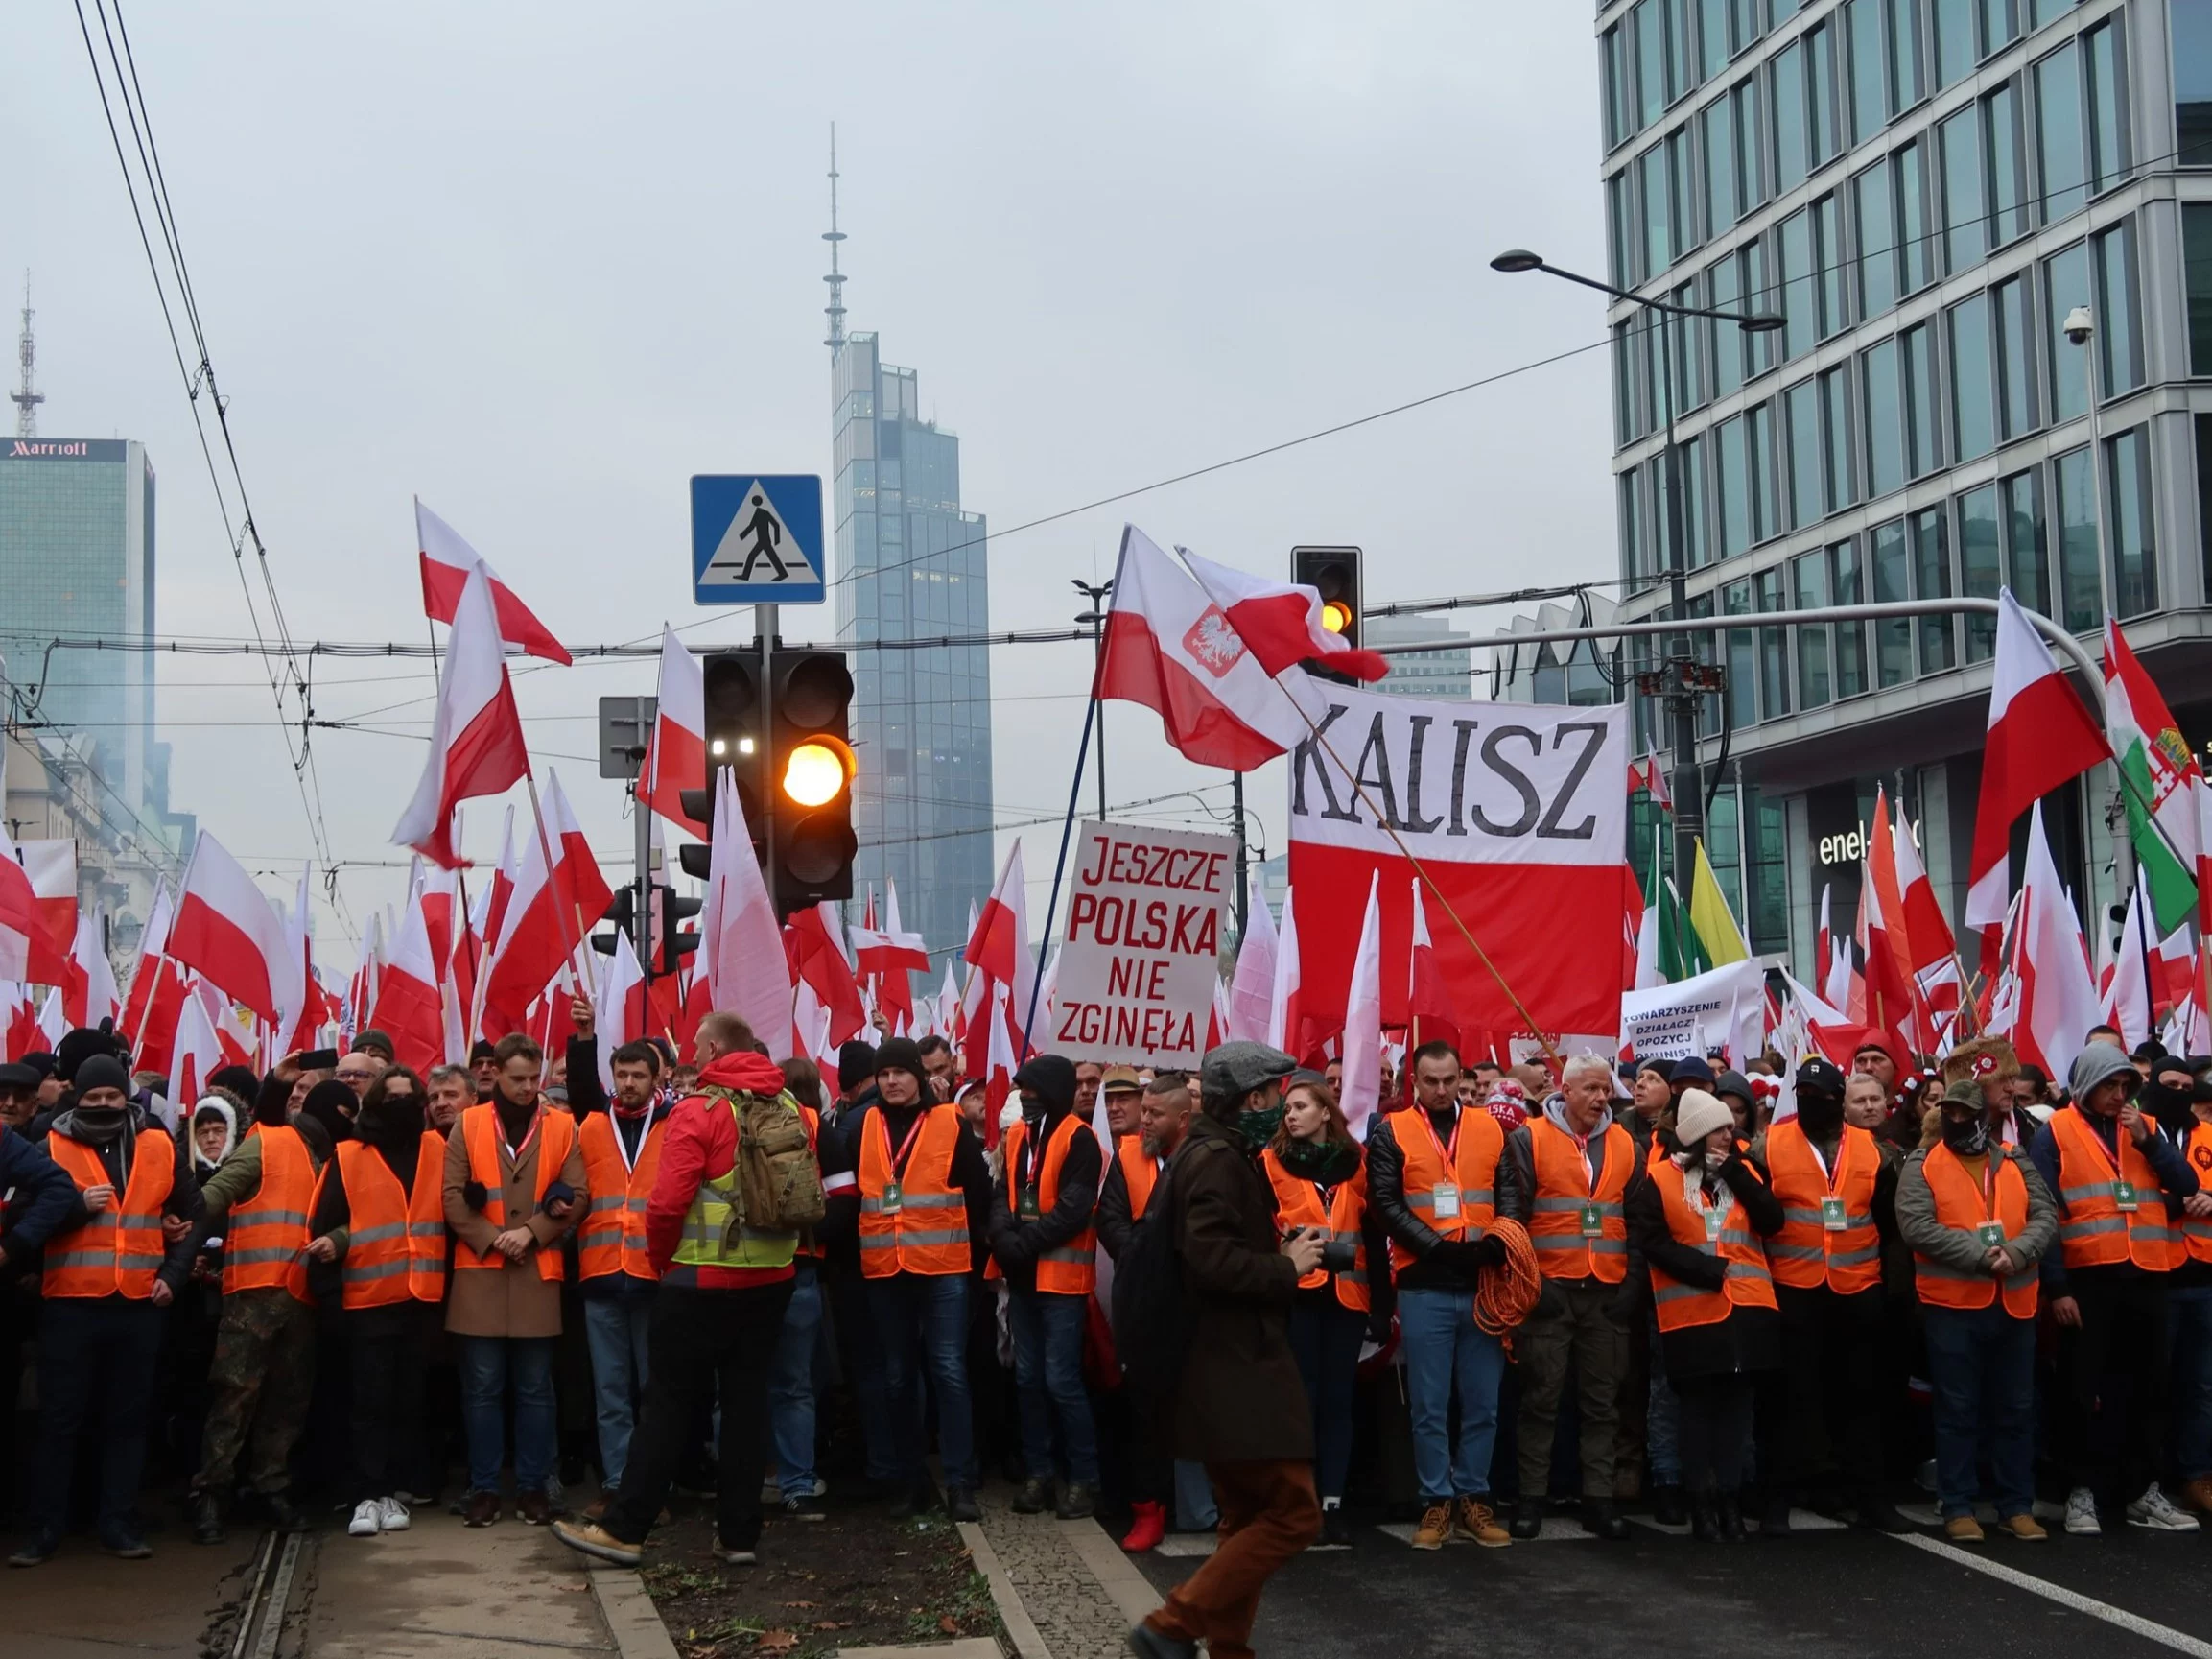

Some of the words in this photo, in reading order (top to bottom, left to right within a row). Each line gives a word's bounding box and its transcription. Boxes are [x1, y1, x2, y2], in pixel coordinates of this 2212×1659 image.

[9, 440, 87, 457] Marriott
[1292, 703, 1609, 840] KALISZ
[1081, 836, 1229, 894] JESZCZE
[1068, 892, 1218, 957] POLSKA
[1107, 956, 1171, 1001] NIE
[1057, 1001, 1196, 1055] ZGINĘŁA
[1488, 1104, 1516, 1118] LSKA
